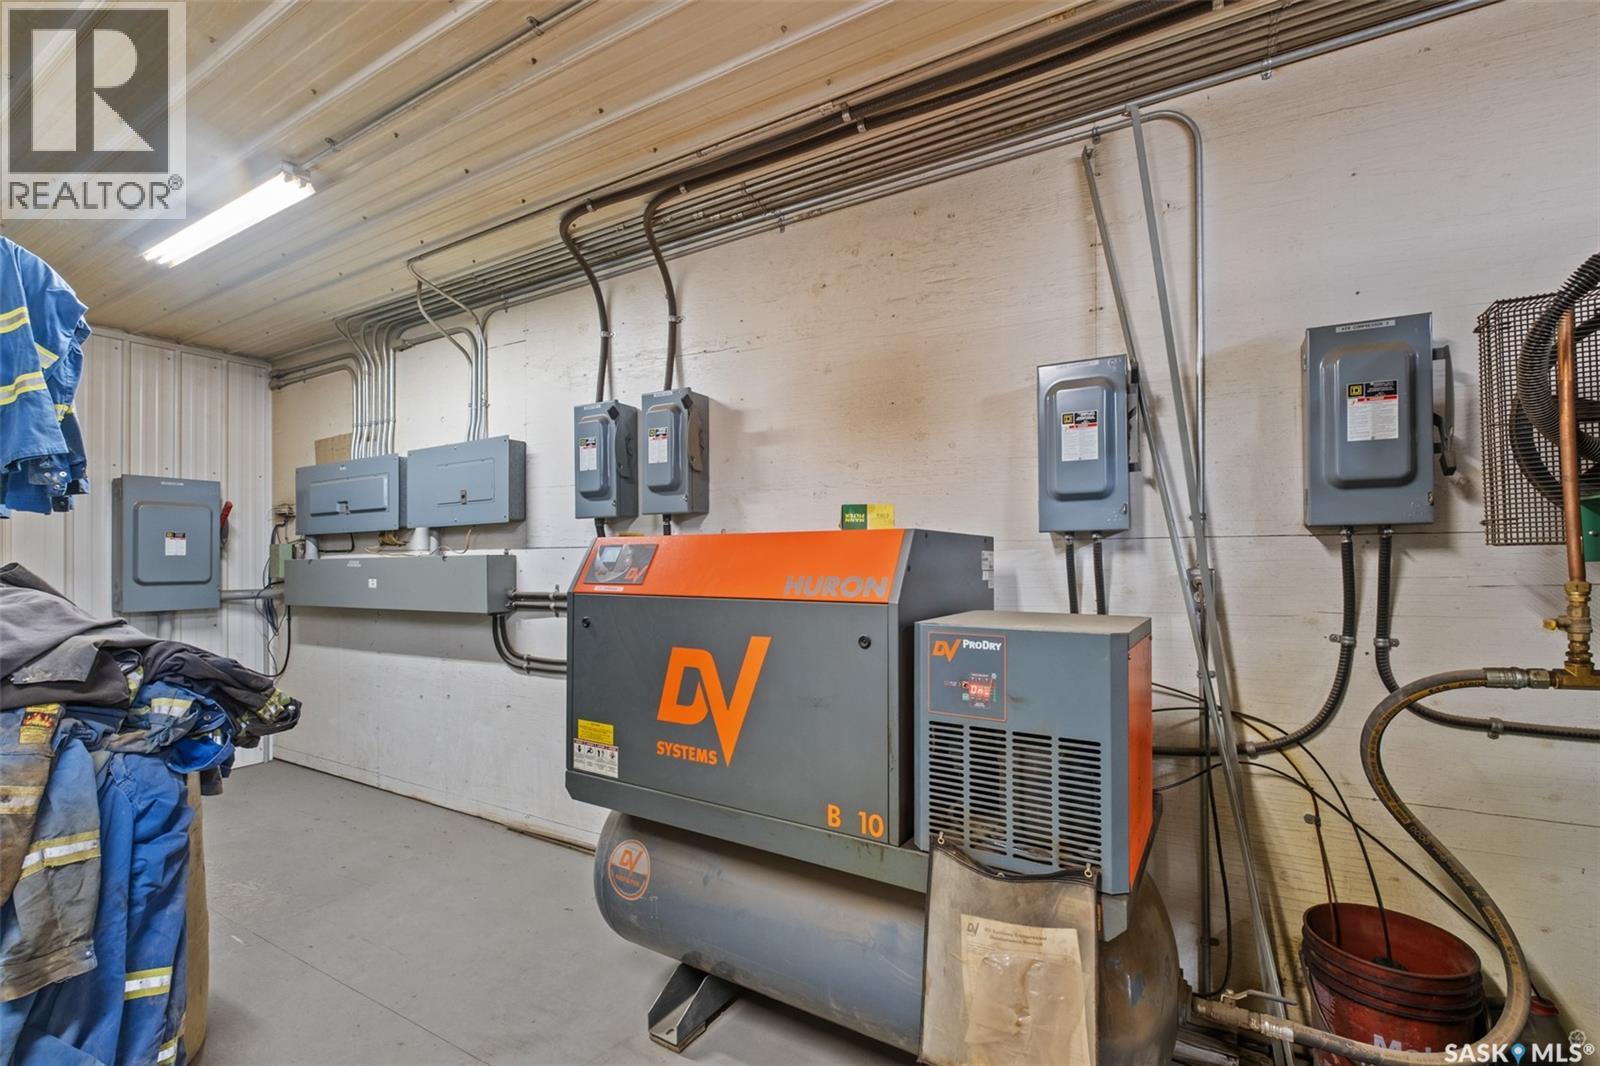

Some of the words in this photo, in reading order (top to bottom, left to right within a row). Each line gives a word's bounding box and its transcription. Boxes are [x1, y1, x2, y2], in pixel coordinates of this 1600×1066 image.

[784, 575, 888, 598] HURON
[932, 638, 961, 662] DV
[657, 635, 772, 768] DV
[656, 740, 718, 765] SYSTEMS
[827, 803, 842, 828] B
[857, 810, 885, 838] 10
